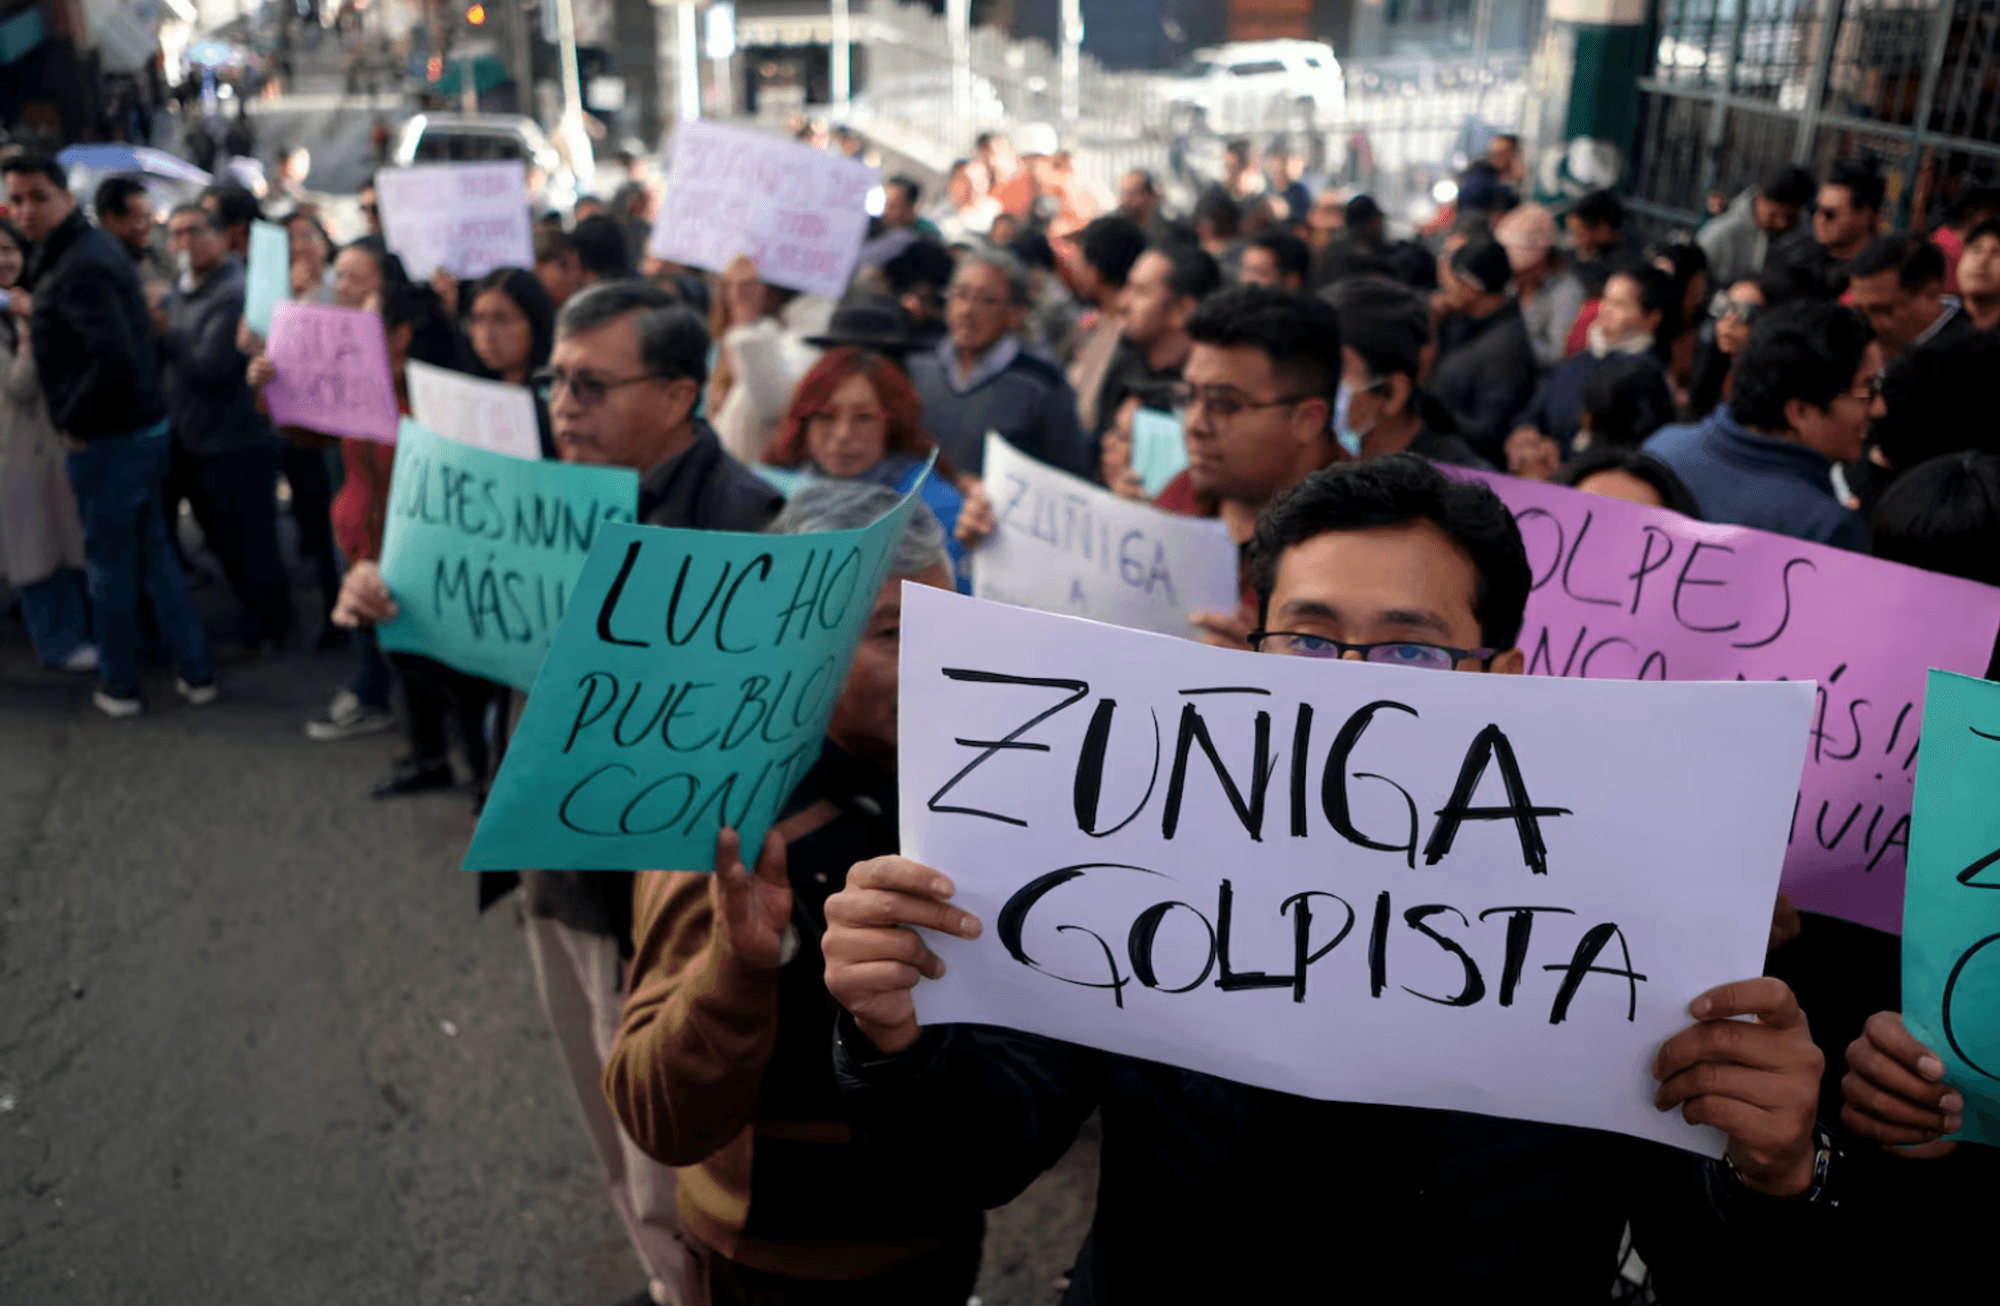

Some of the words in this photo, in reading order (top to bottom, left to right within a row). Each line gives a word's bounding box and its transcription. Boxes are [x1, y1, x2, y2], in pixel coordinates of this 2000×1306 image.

[396, 446, 506, 541] OLPES
[513, 493, 634, 554] NUN
[999, 472, 1178, 608] ZUÑIGA
[596, 540, 861, 654] LUCHO
[1513, 507, 1817, 648] OLPES
[562, 655, 835, 755] PUEBLO
[927, 667, 1574, 876] ZUÑIGA
[996, 861, 1648, 1025] GOLPISTA
